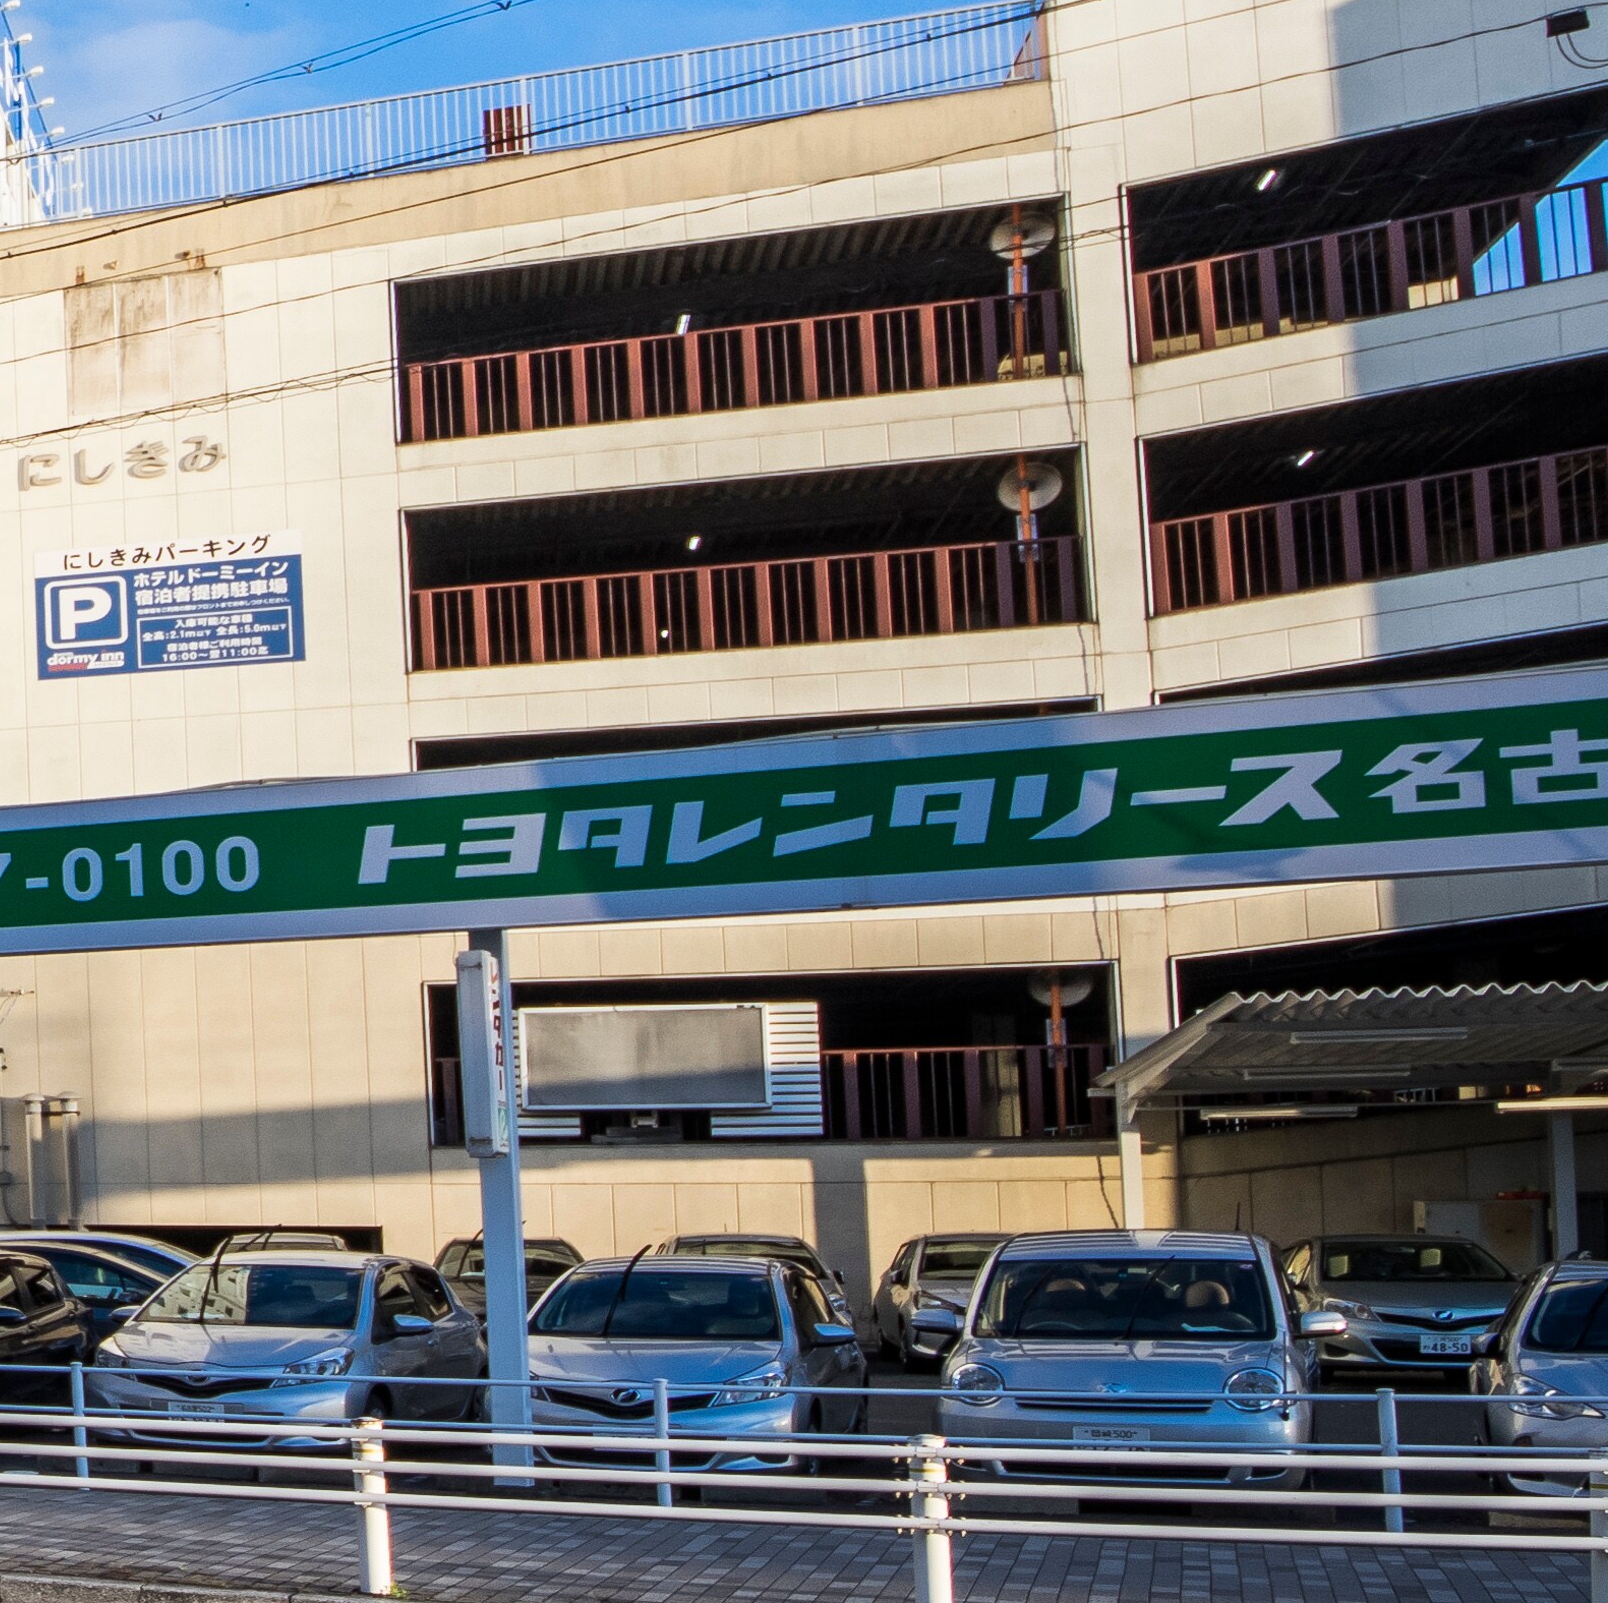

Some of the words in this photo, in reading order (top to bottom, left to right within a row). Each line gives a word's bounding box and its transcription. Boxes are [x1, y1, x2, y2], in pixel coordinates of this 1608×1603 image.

[17, 434, 228, 492] にしきみ
[63, 533, 272, 571] にしきみパーキング
[133, 561, 289, 587] ホテルドーミーイン
[59, 586, 113, 640] P
